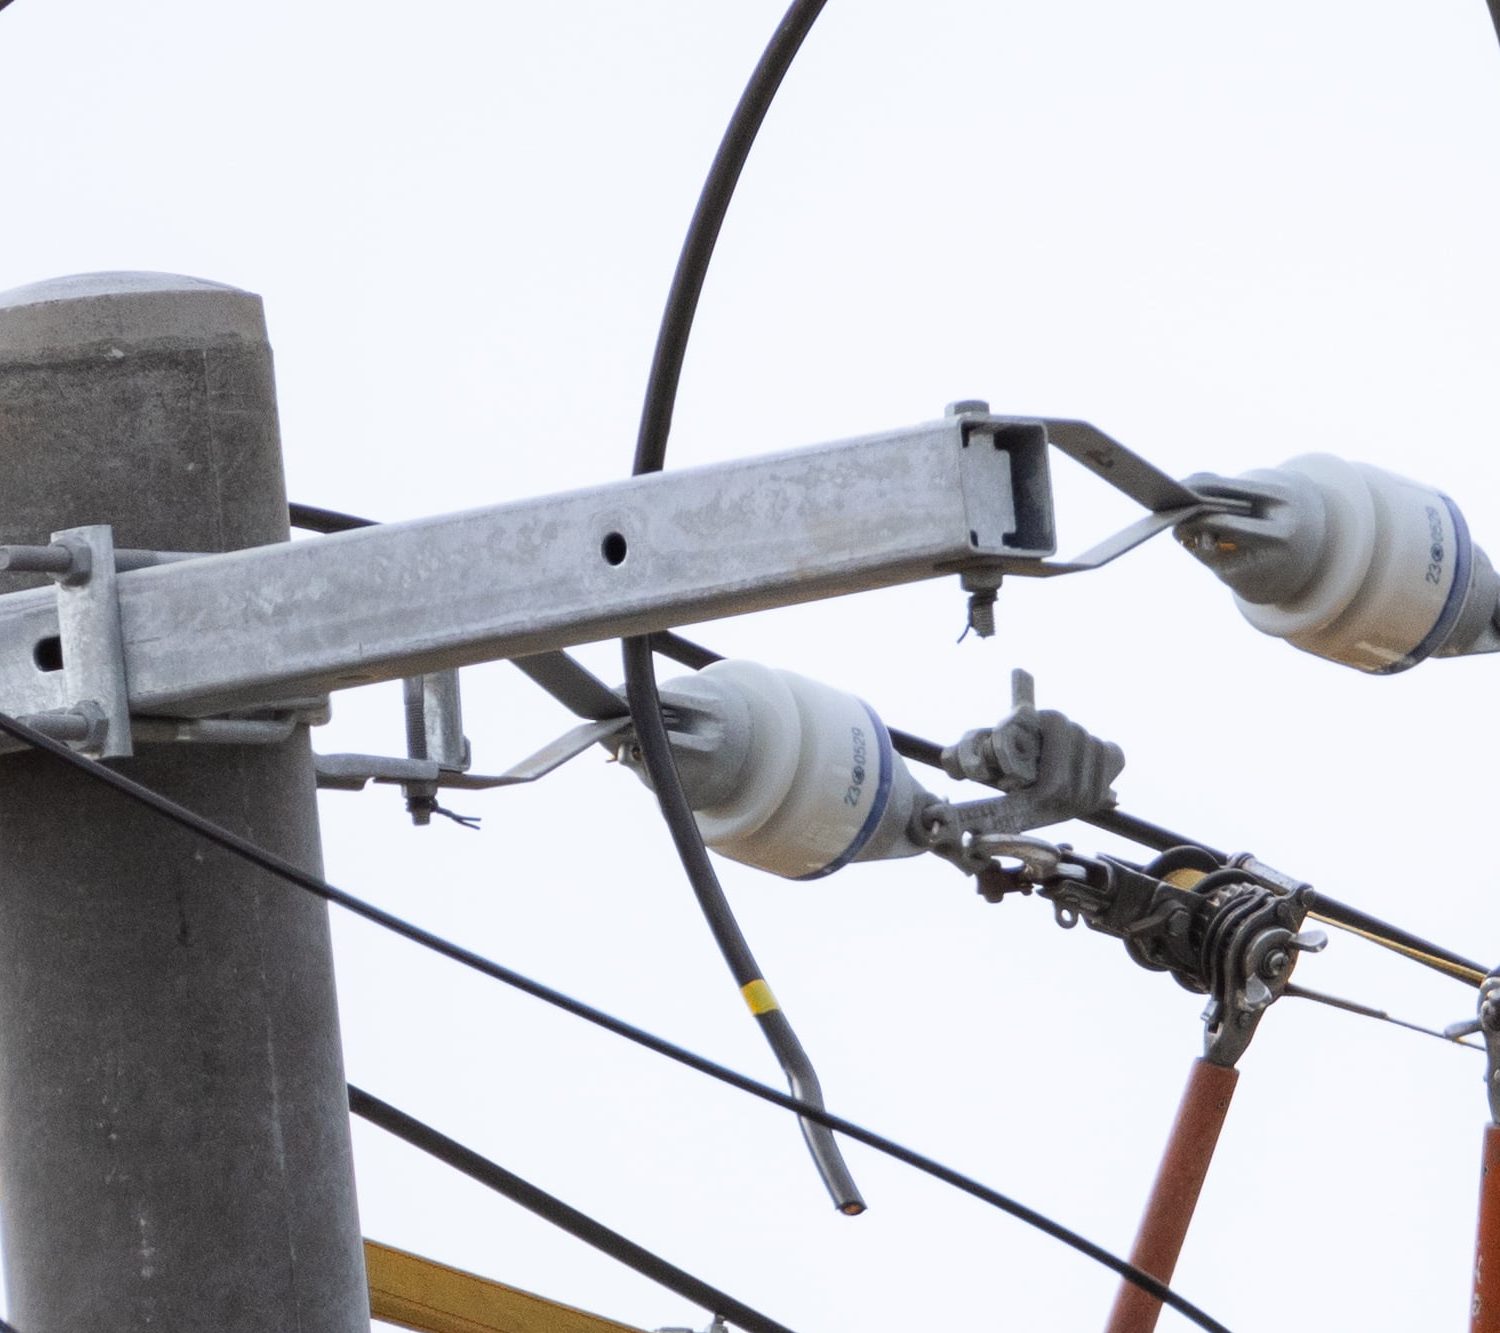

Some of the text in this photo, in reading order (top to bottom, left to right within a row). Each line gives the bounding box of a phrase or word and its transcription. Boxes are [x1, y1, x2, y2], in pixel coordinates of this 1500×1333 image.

[1424, 562, 1442, 585] 23
[843, 726, 866, 807] 23 0529
